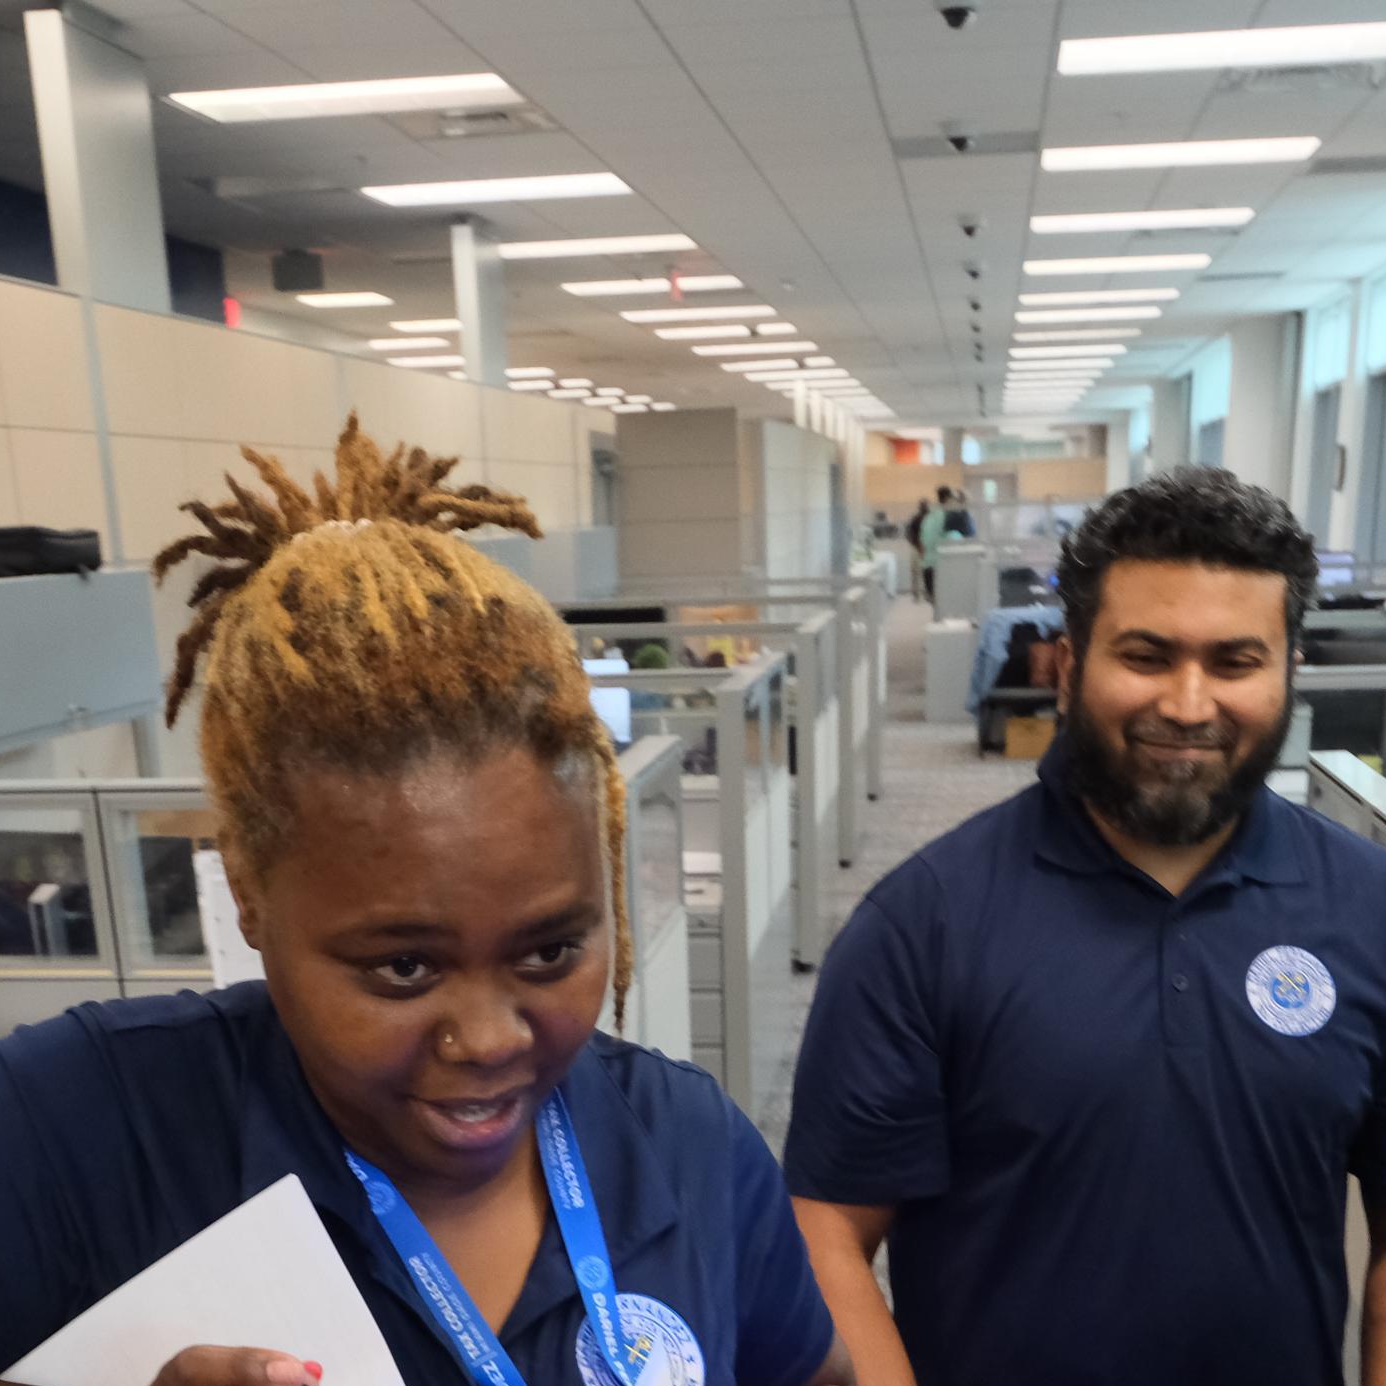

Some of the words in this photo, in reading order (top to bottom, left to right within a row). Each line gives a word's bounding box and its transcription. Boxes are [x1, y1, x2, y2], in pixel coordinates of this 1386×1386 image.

[552, 1127, 585, 1208] COLLECTOR
[407, 1254, 464, 1333] COLLECTOR
[591, 1290, 620, 1358] DANIEL
[456, 1329, 482, 1360] TAX
